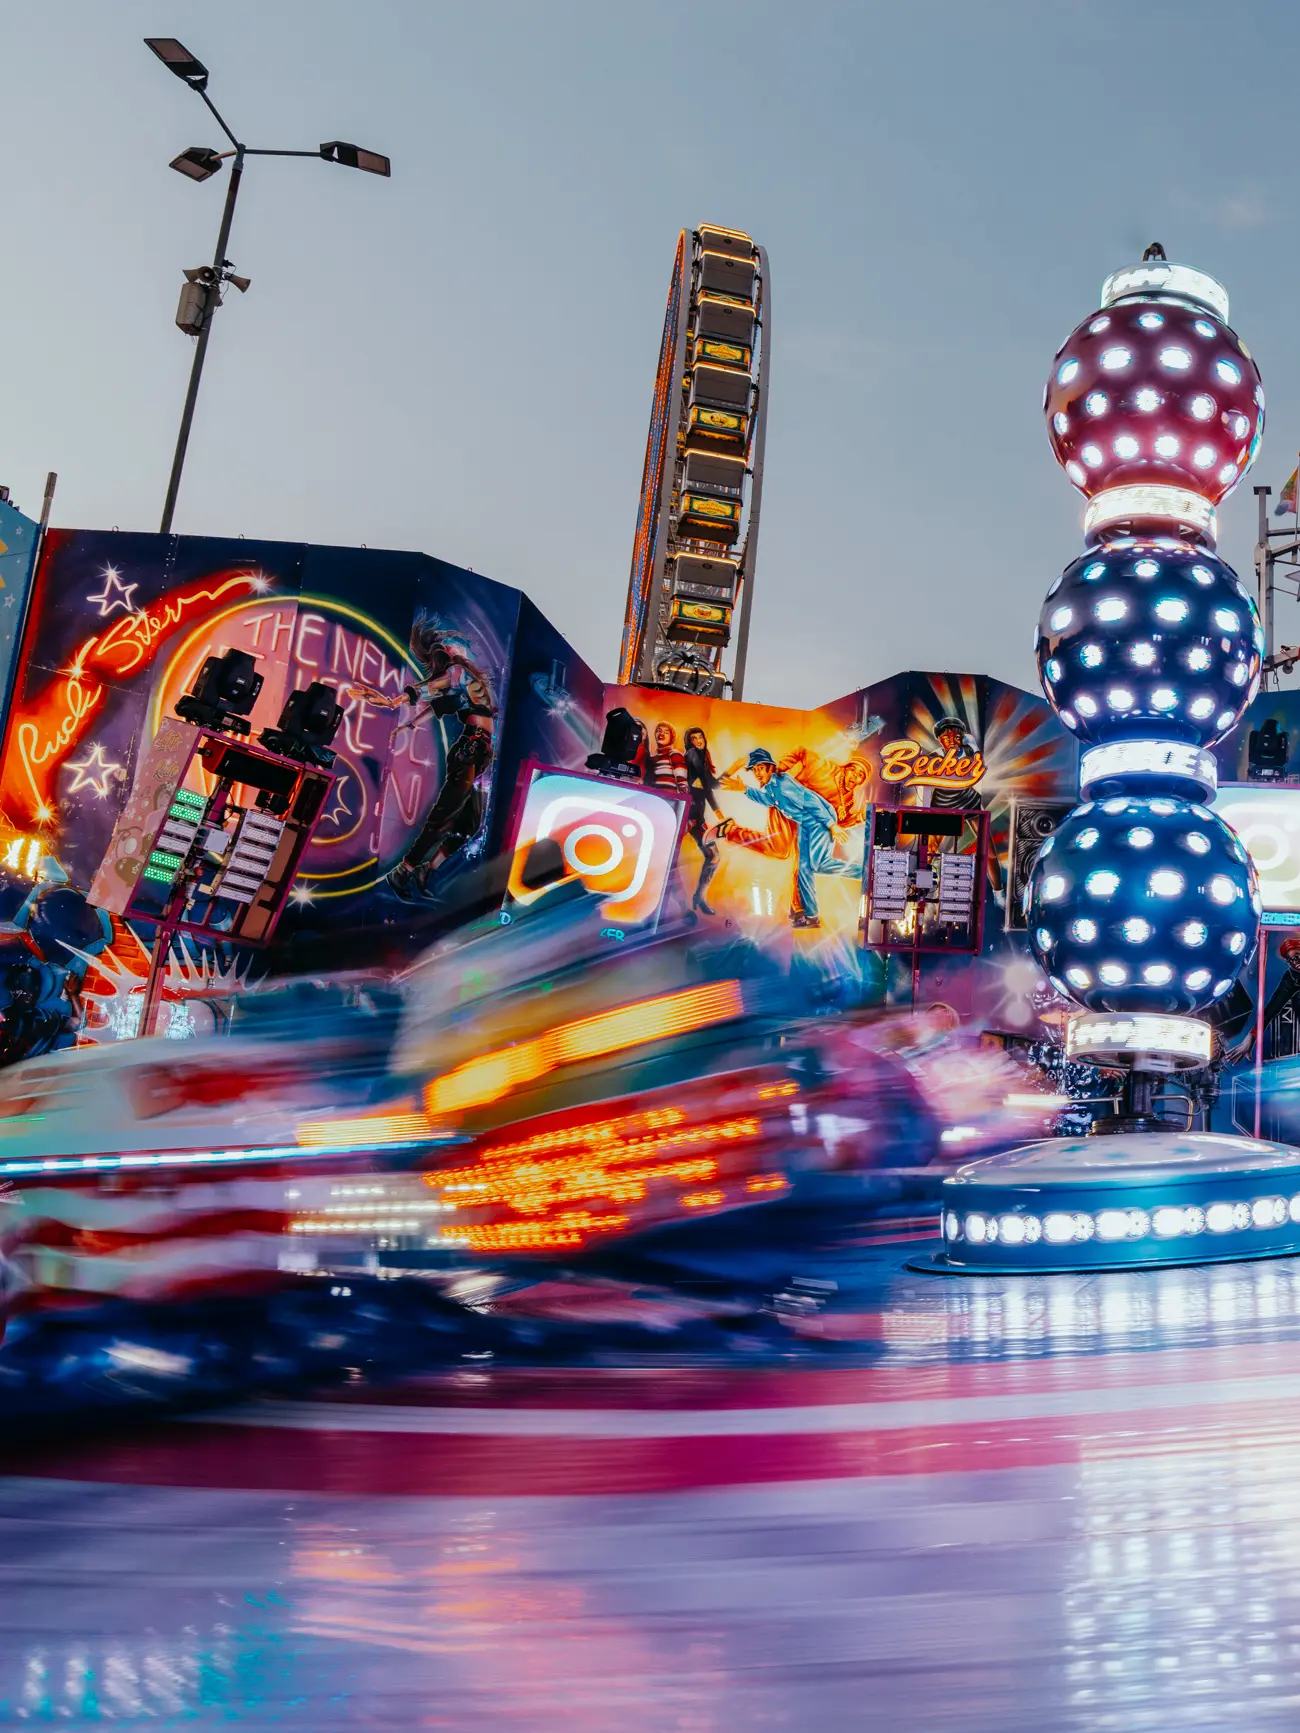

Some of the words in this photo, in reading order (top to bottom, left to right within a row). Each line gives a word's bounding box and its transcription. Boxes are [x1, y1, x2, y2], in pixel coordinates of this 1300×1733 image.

[243, 612, 326, 667] THE
[330, 623, 407, 694] NEW
[879, 739, 987, 789] Becker
